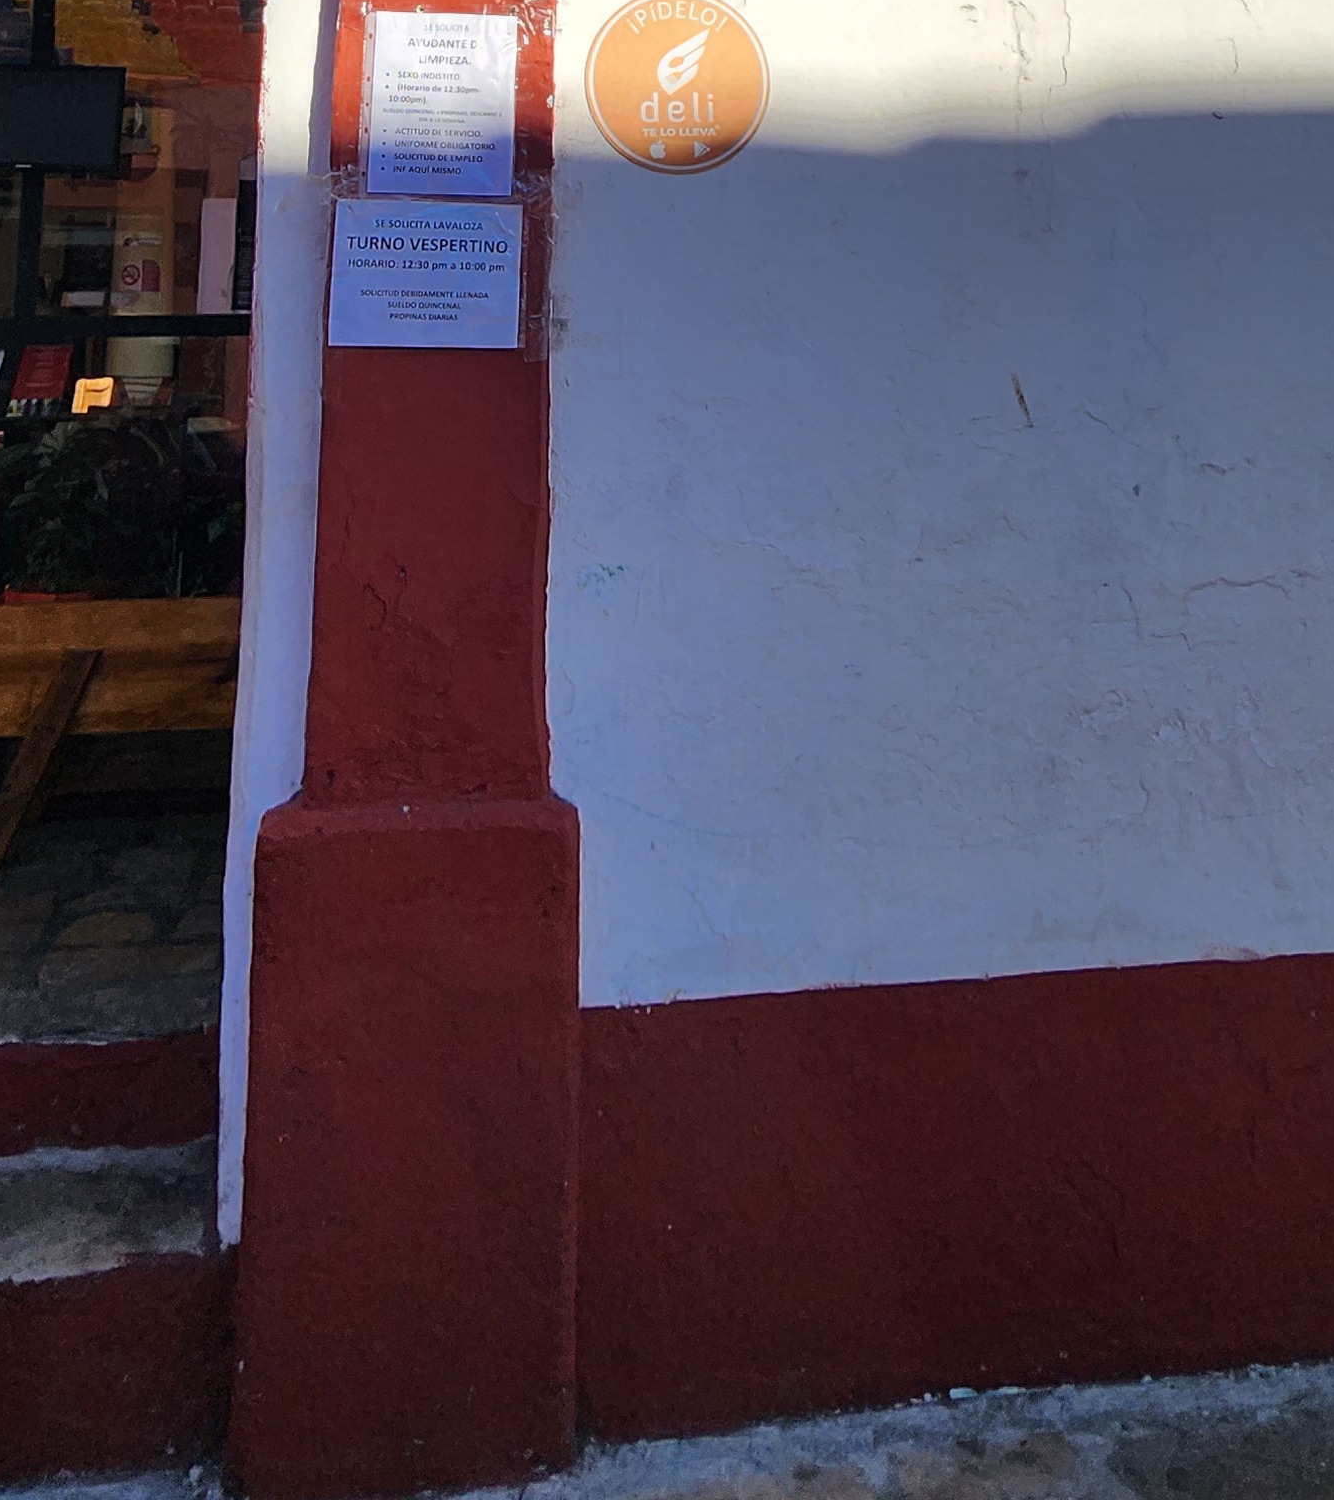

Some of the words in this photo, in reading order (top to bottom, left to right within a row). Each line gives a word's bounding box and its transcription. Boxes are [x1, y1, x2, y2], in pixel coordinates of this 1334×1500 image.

[625, 0, 729, 35] ¡PÍDELO!
[434, 24, 470, 33] SOLICITA
[407, 37, 467, 49] AYUDANTE
[418, 55, 472, 66] LIMPIEZA.
[398, 71, 419, 80] SEXO
[397, 83, 430, 93] (Horario
[431, 85, 442, 93] de
[640, 91, 714, 123] deli
[395, 128, 430, 136] ACTITUD
[444, 129, 484, 138] SERVICIO.
[642, 127, 657, 137] TE
[660, 127, 676, 137] LO
[394, 140, 438, 149] UNIFORME
[393, 152, 436, 161] SOLICITUD
[437, 153, 448, 161] DE
[393, 165, 407, 173] INF
[408, 165, 430, 174] AQUÍ
[375, 218, 386, 228] SE
[388, 219, 431, 229] SOLICITA
[433, 221, 484, 231] LAVALOZA
[347, 236, 405, 251] TURNO
[409, 238, 508, 254] VESPERTINO
[347, 258, 400, 270] HORARIO:
[402, 260, 430, 270] 12:30
[431, 263, 448, 272] pm
[459, 261, 487, 272] 10:00
[488, 264, 505, 273] pm
[360, 289, 400, 298] SOLICITUD
[401, 290, 454, 298] DEBIDAMENTE
[456, 291, 489, 299] LLENADA
[388, 301, 417, 309] SUELDO
[418, 302, 461, 310] QUINCENAL
[389, 313, 427, 321] PROPINAS
[428, 313, 458, 321] DIARIAS
